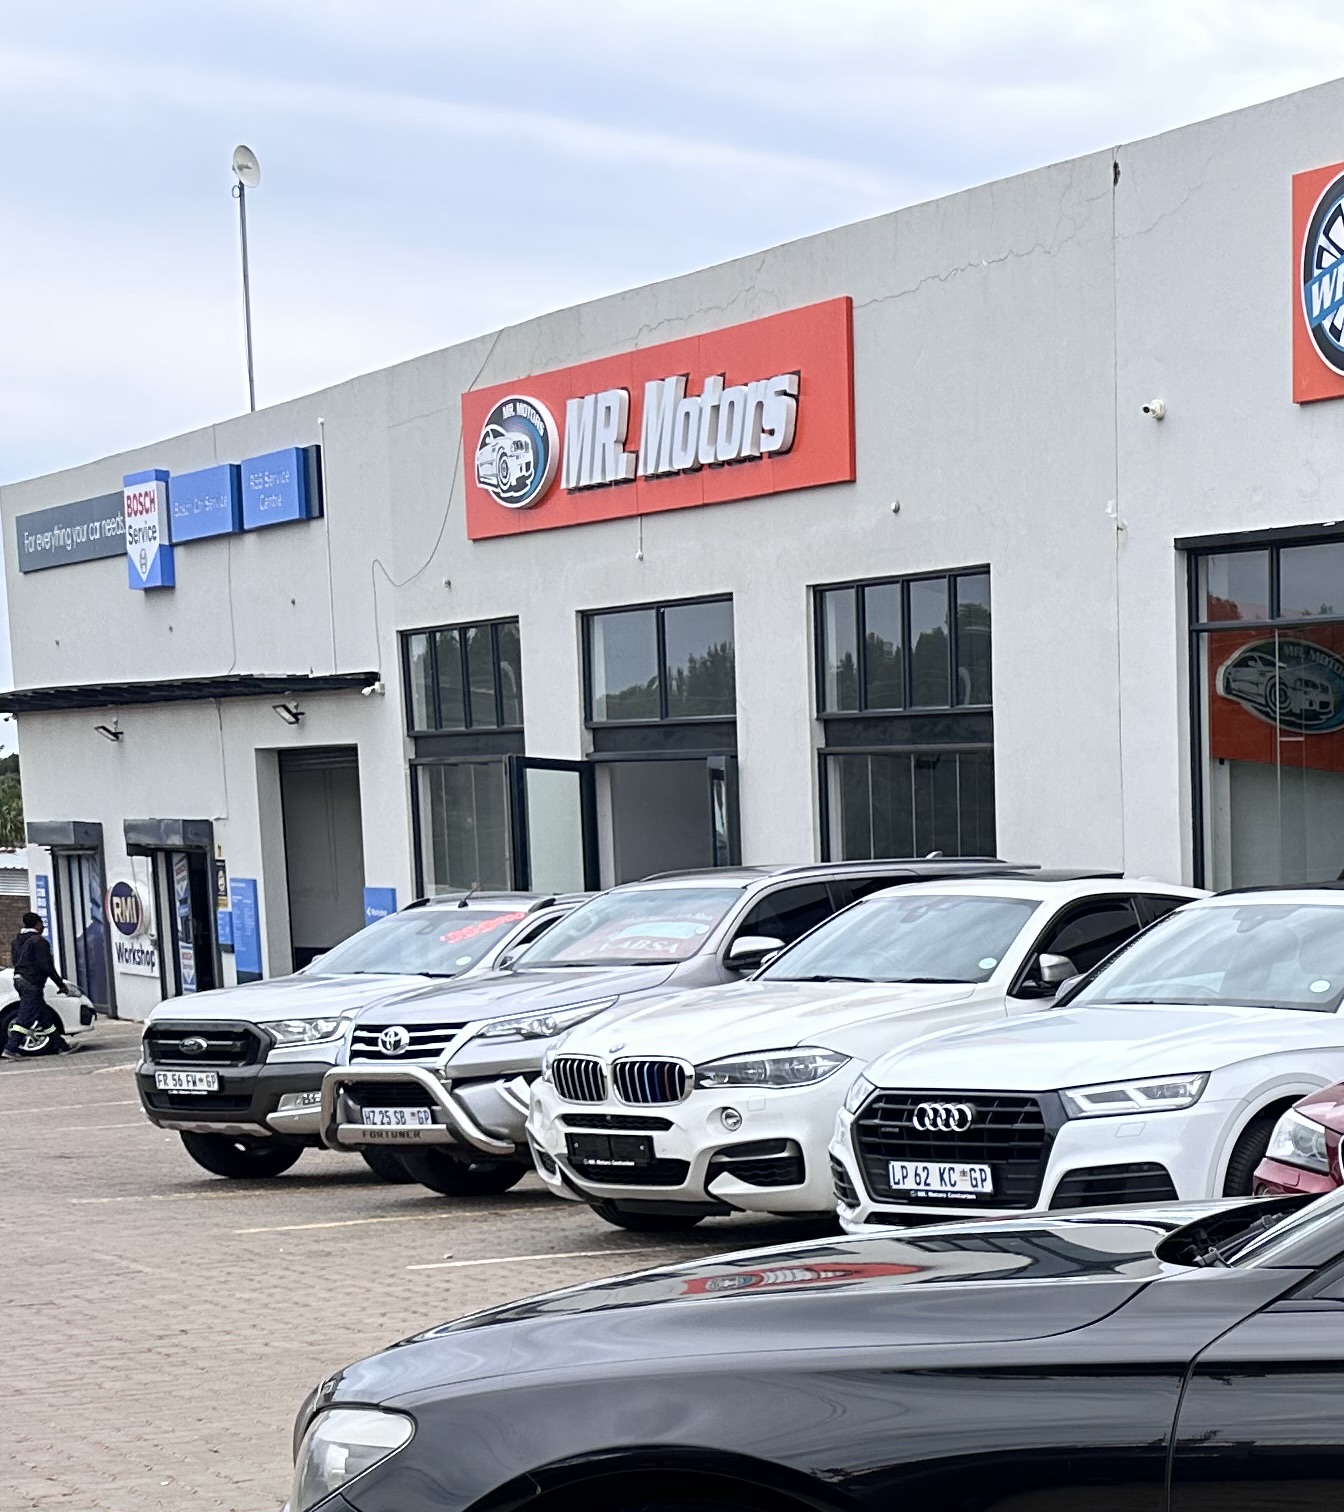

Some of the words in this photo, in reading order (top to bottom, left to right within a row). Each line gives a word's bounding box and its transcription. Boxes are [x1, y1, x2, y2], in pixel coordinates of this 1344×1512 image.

[516, 402, 545, 437] MOTORS
[561, 388, 638, 490] MR.
[638, 372, 799, 478] Motors
[127, 490, 156, 517] BOSCH
[24, 532, 35, 553] For
[36, 524, 72, 552] everything
[72, 525, 87, 549] your
[89, 521, 101, 541] car
[128, 520, 157, 545] Service
[115, 942, 155, 973] Workshop
[205, 1074, 217, 1088] GP
[379, 1110, 391, 1125] 25
[417, 1110, 430, 1125] GP
[362, 1130, 421, 1139] FORTUNER
[892, 1164, 908, 1185] LP
[914, 1166, 931, 1187] 62
[939, 1167, 957, 1188] KC
[969, 1168, 987, 1189] GP
